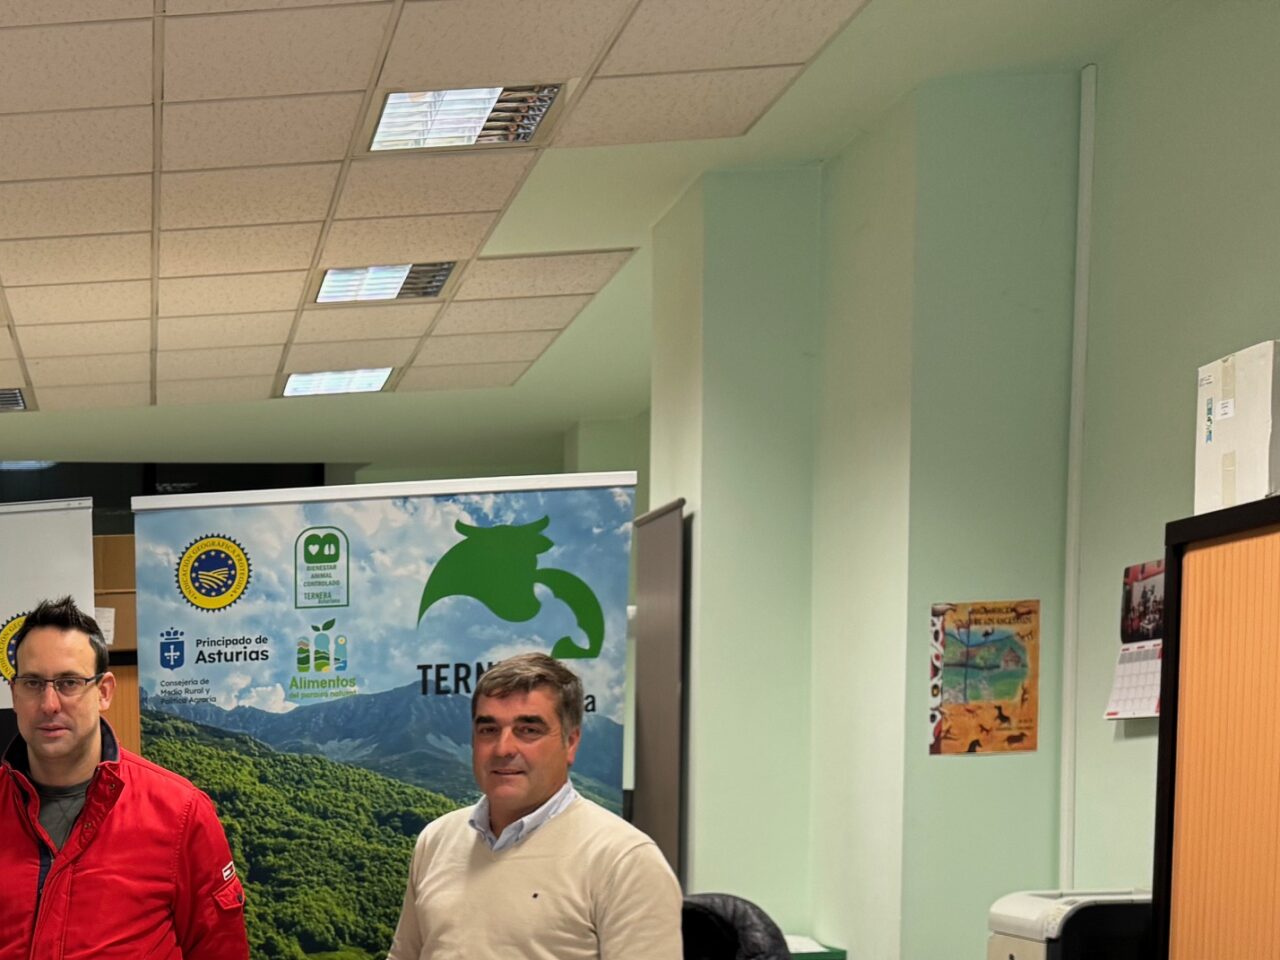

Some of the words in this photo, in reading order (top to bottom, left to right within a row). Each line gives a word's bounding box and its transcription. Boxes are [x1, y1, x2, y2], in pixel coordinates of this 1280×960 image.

[306, 563, 338, 572] BIENESTAR
[310, 572, 333, 580] ANIMAL
[303, 579, 341, 588] CONTROLADO
[303, 591, 332, 601] TERNERA
[195, 636, 252, 648] Principado
[254, 635, 269, 645] de
[194, 646, 269, 664] Asturias
[199, 678, 210, 686] de
[288, 675, 357, 690] Alimentos
[160, 688, 183, 697] Medio
[184, 687, 204, 695] Rural
